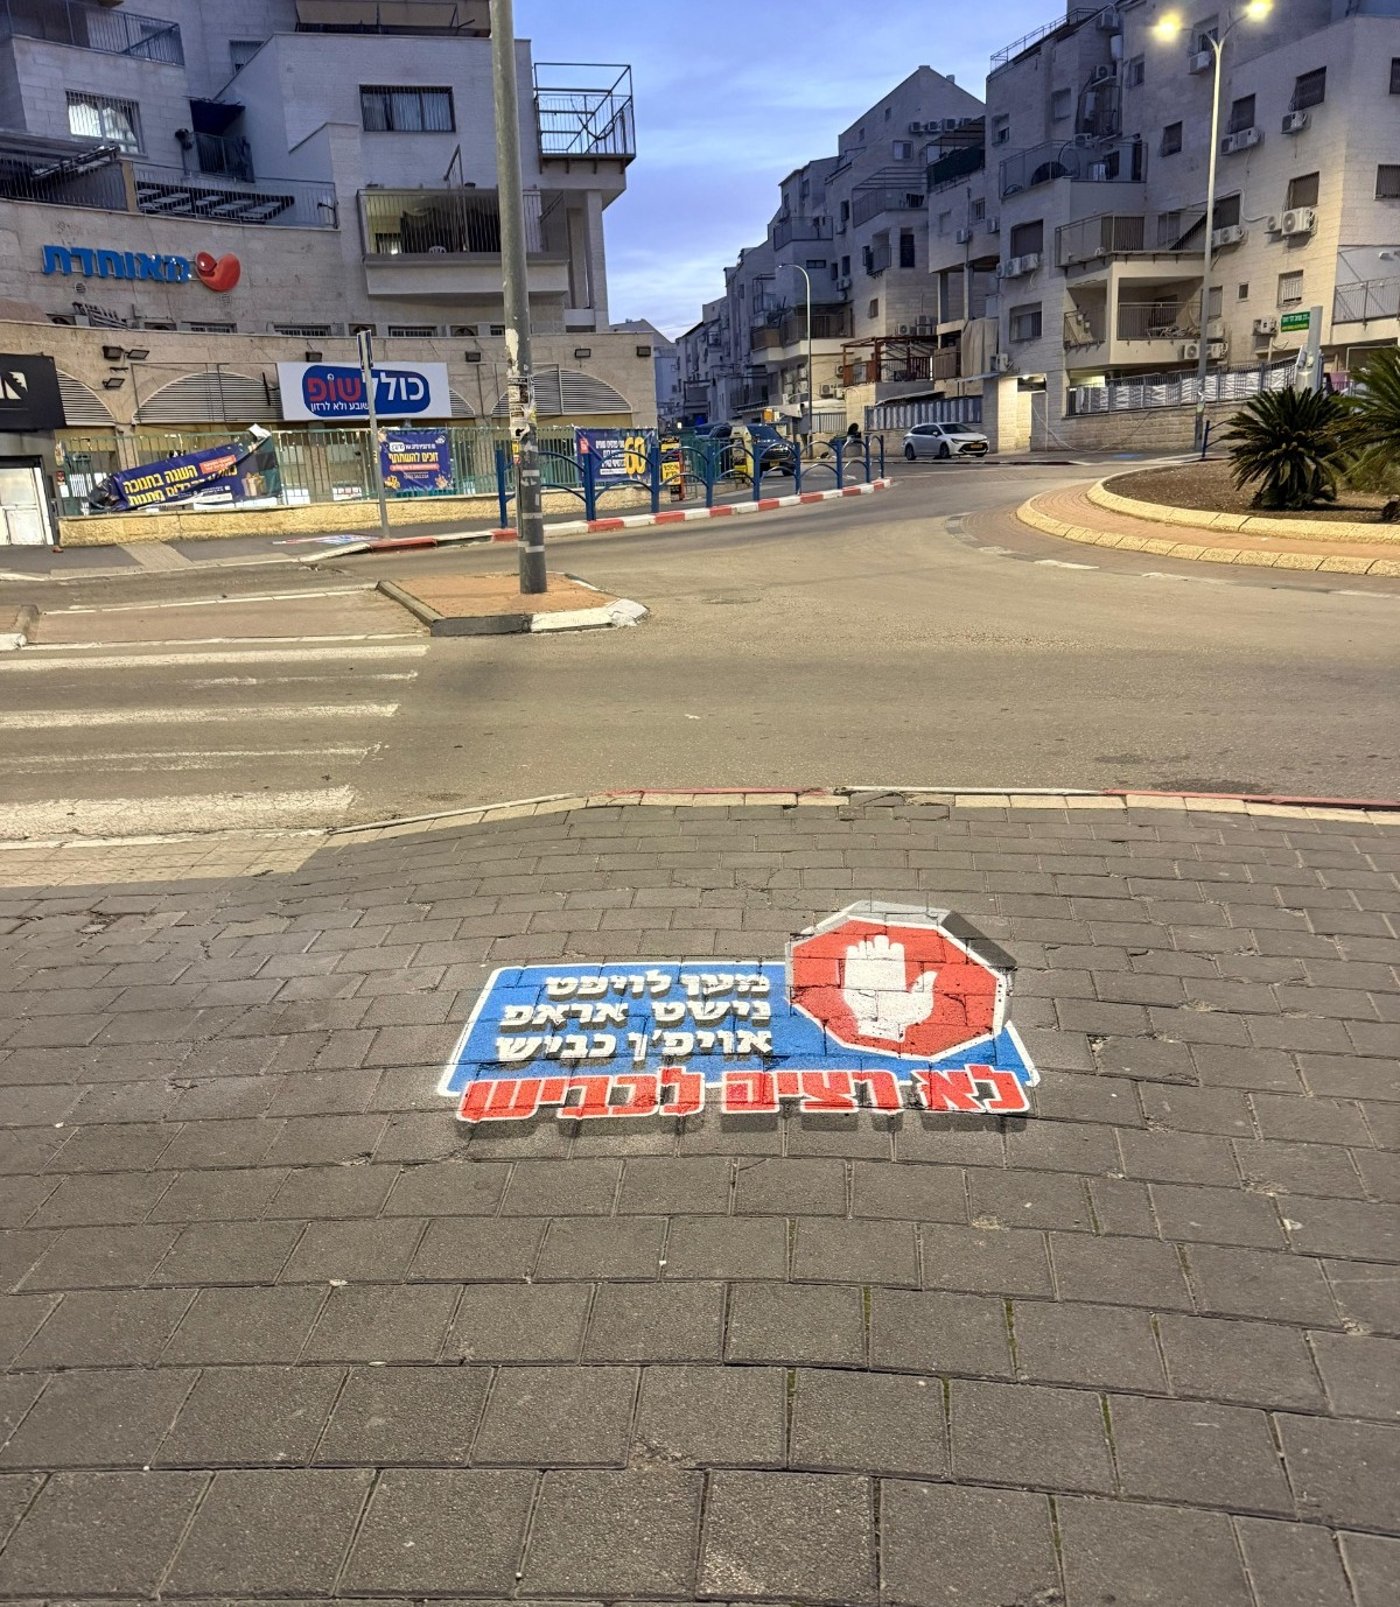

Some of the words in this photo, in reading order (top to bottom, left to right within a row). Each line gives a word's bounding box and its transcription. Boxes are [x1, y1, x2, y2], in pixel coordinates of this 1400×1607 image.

[41, 244, 191, 284] מאוחדת
[310, 402, 330, 412] לרזון
[333, 401, 347, 411] ולא
[122, 473, 165, 494] בחנוכה
[164, 465, 199, 484] השנה
[545, 969, 673, 996] לויפט
[651, 1000, 772, 1021] נישט
[496, 1034, 617, 1061] כביש
[456, 1066, 705, 1123] לכביש
[720, 1069, 905, 1115] רצים
[911, 1063, 1031, 1114] לא
